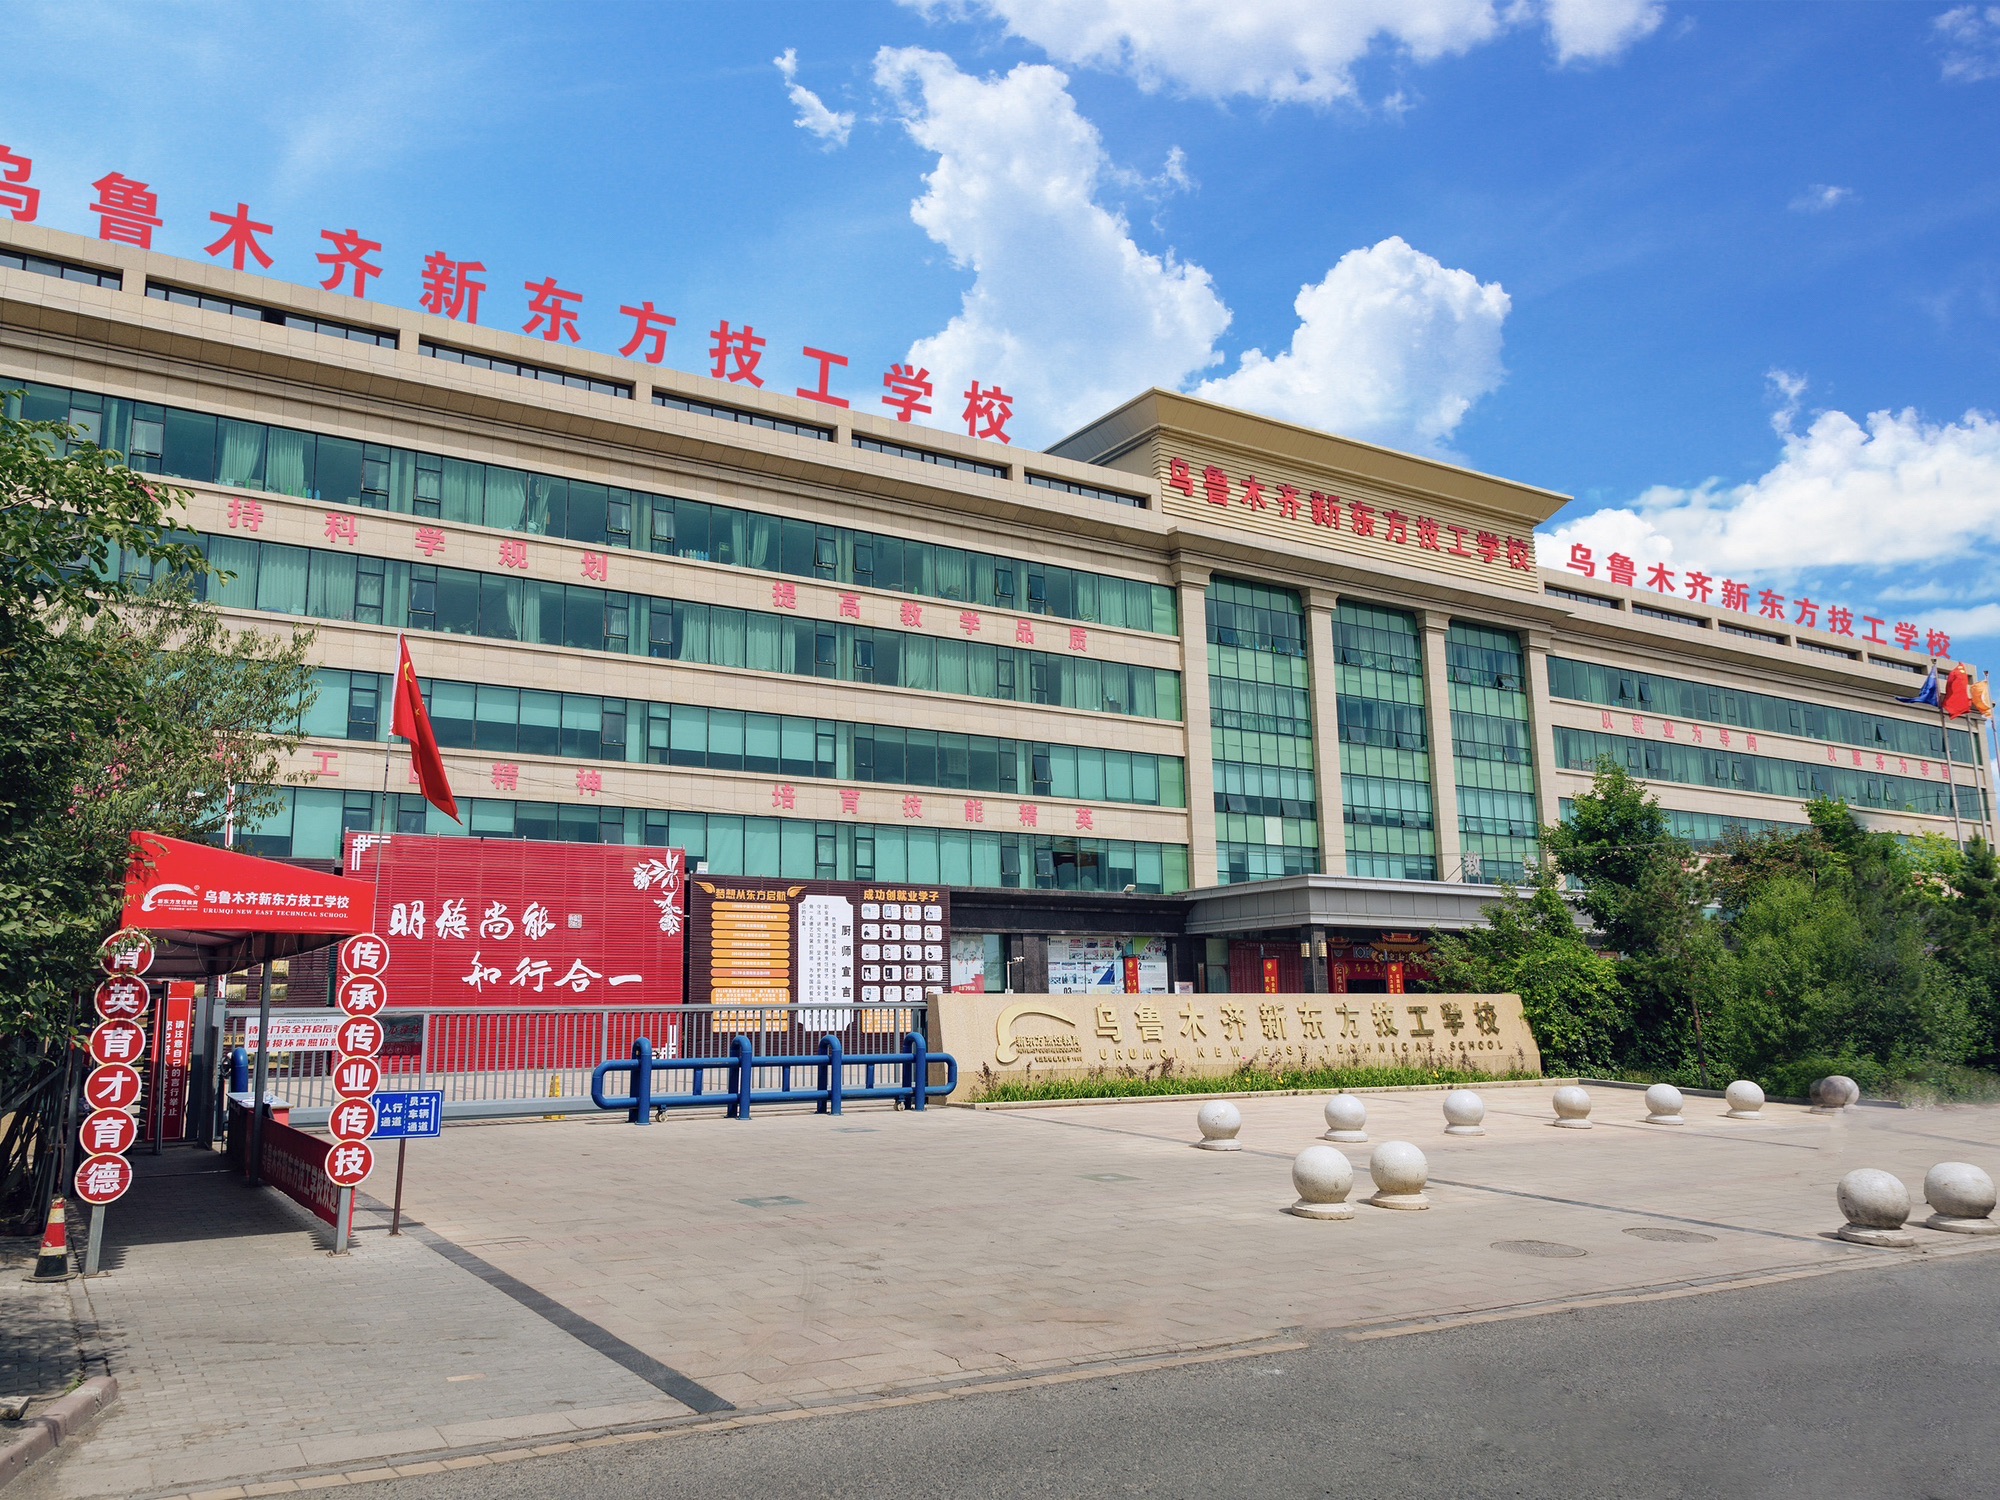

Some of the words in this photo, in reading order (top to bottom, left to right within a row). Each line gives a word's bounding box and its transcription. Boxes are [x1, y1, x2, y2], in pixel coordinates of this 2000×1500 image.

[0, 144, 1014, 444] 乌鲁木齐新东方技工学校
[1169, 457, 1531, 571] 乌鲁木齐新东方技工学校
[128, 481, 608, 582] 持科学规划
[772, 581, 1088, 653] 提高教学品质
[1566, 543, 1951, 659] 乌鲁木齐新东方技工学校
[1601, 711, 1758, 751] 以就业为导向
[772, 784, 1093, 831] 培育技能精英
[203, 889, 350, 909] 乌鲁木齐新东方技工学校
[715, 888, 787, 901] 梦想从东方启航
[863, 889, 939, 902] 成功创就业学子
[388, 898, 556, 941] 明德尚能
[841, 925, 851, 998] 厨师宣言
[248, 1024, 340, 1035] 待门完全开启后
[1094, 1000, 1501, 1043] 乌鲁木齐新东方技工学校
[168, 1020, 185, 1116] 请注意自己的言行举止
[335, 941, 380, 1177] 传承传业传技
[1099, 1048, 1179, 1060] URUMQI
[1196, 1045, 1241, 1058] NEW
[1261, 1044, 1305, 1056] EAST
[1324, 1043, 1435, 1055] TECHNICAL
[1450, 1041, 1504, 1051] SCHOOL
[380, 1116, 402, 1127] 通道
[381, 1103, 403, 1114] 人行
[408, 1108, 430, 1119] 车辆
[409, 1096, 430, 1107] 员工
[407, 1121, 429, 1132] 通道
